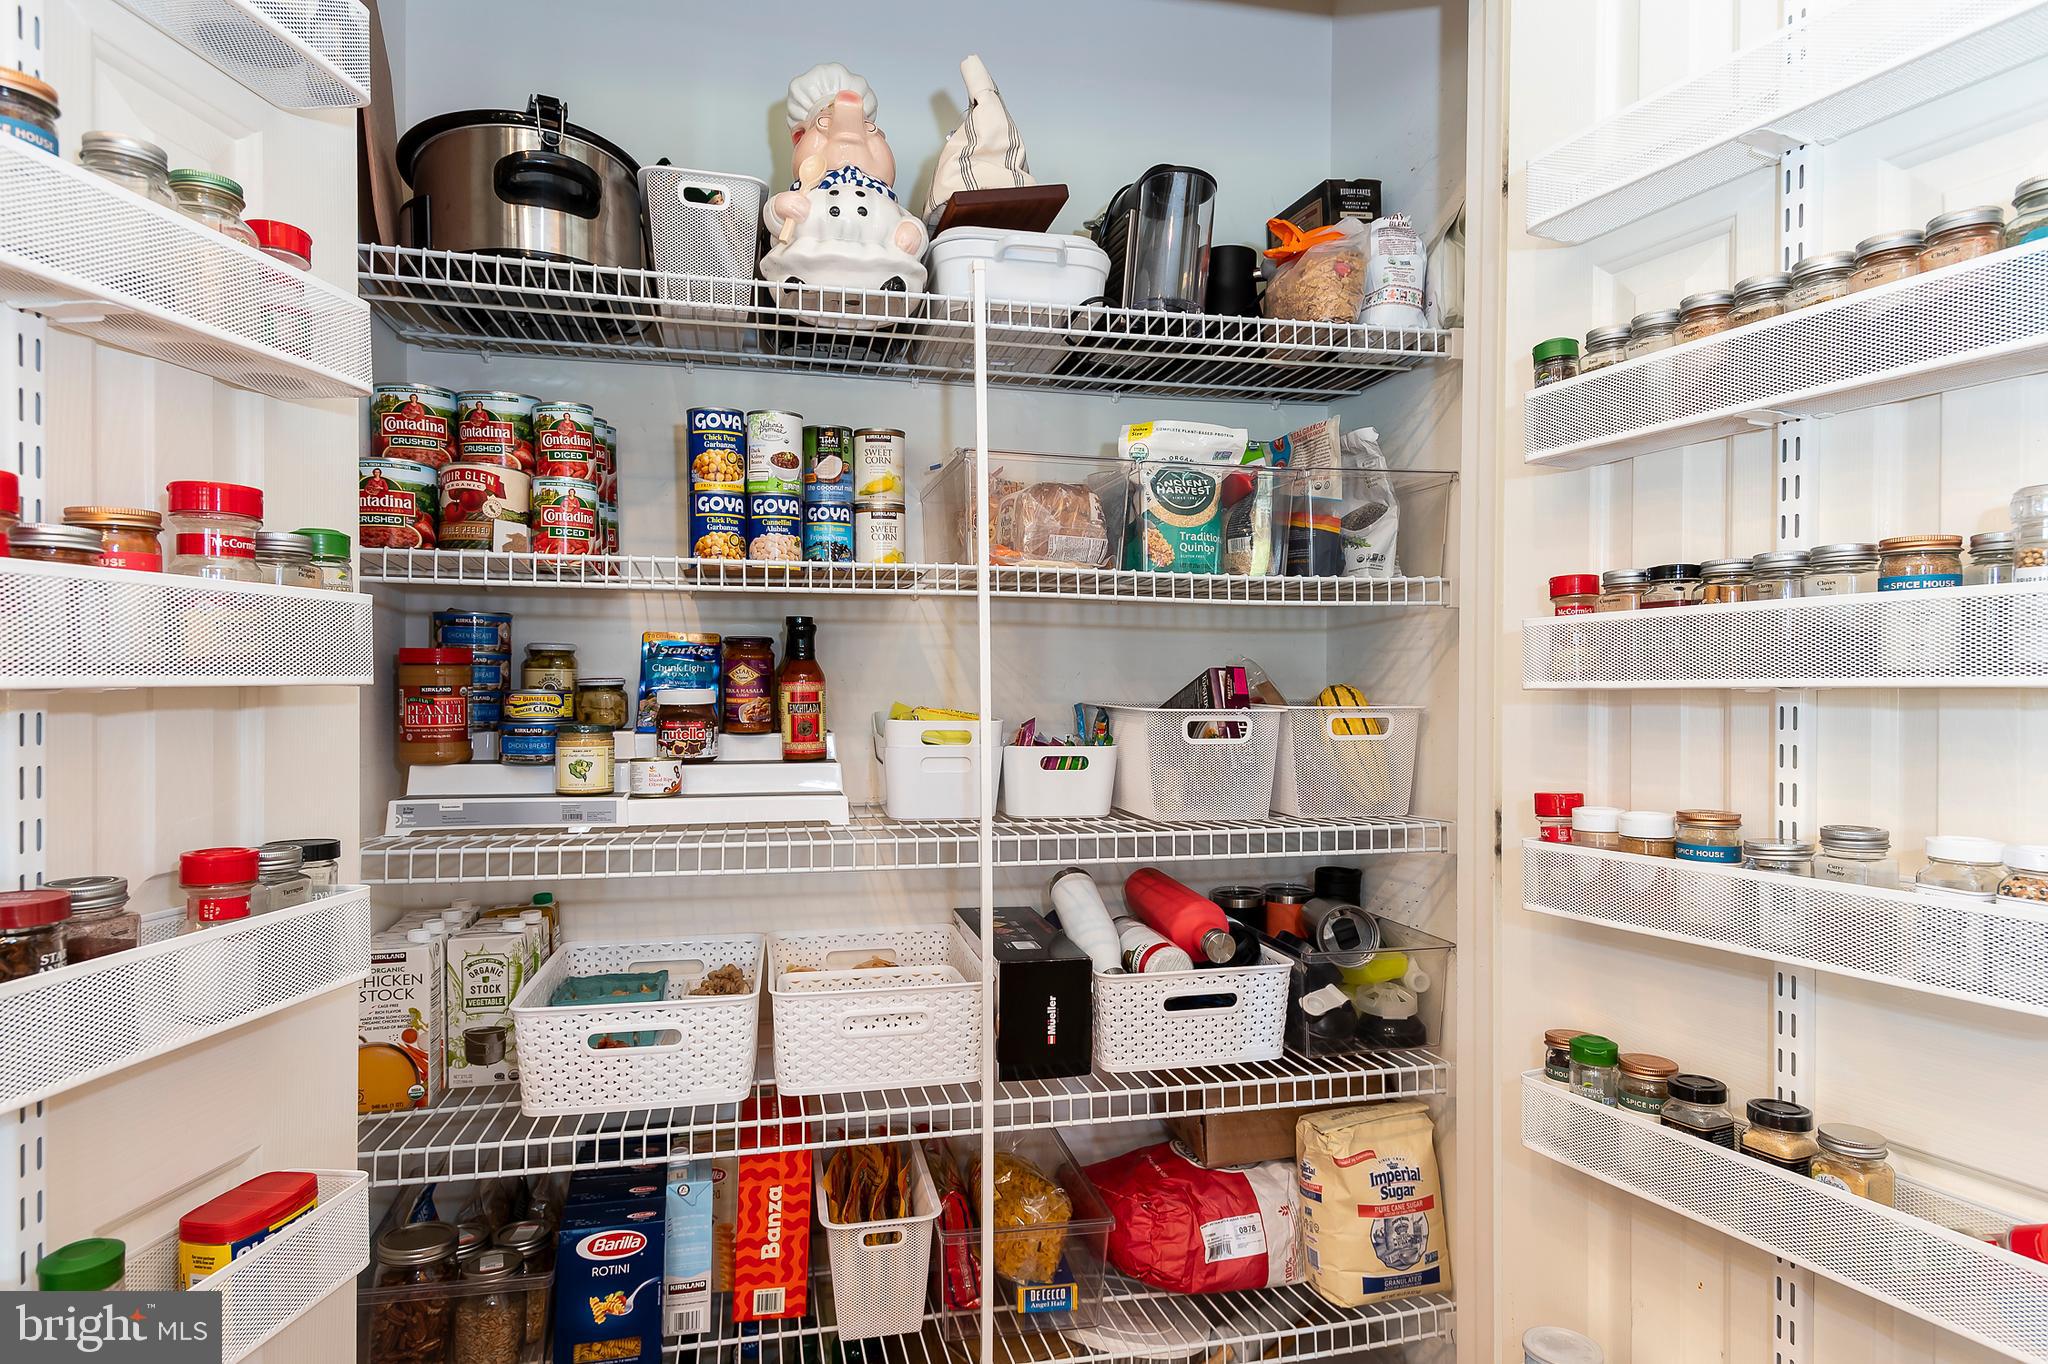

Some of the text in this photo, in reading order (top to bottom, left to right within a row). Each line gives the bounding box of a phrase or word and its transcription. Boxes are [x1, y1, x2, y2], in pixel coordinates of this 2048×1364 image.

[1931, 246, 1961, 259] Chipotle
[383, 416, 445, 434] Contadina
[695, 413, 742, 430] GOYA
[460, 424, 511, 439] Contadina
[392, 437, 437, 447] CRUSHED
[542, 433, 591, 447] Contadina
[704, 441, 736, 449] Garbanzos
[819, 436, 839, 444] THAI
[464, 444, 501, 453] CRUSHED
[864, 449, 892, 457] SWEET
[554, 451, 583, 459] DICED
[865, 456, 891, 464] CORN
[465, 470, 495, 486] GLEN
[1157, 479, 1208, 488] ANCIENT
[1156, 485, 1211, 496] HARVEST
[360, 495, 412, 509] ntadina
[698, 496, 744, 513] GOYA
[753, 499, 799, 514] GOYA
[544, 509, 593, 525] Contadina
[808, 507, 850, 521] GOYA
[556, 528, 585, 536] DICED
[707, 524, 739, 532] Garbanzos
[870, 526, 898, 534] SWEET
[871, 533, 897, 541] CORN
[1179, 542, 1215, 555] Quinoa
[1890, 579, 1956, 589] SPICE HOUSE
[660, 645, 715, 656] StarKist
[651, 664, 706, 674] Chunk Light
[408, 705, 462, 715] PEANUT
[533, 706, 560, 715] CLAMS
[789, 703, 820, 712] ENCHILADA
[408, 714, 462, 724] BUTTER
[662, 727, 706, 740] nutella
[1696, 850, 1724, 859] HOUSE
[1827, 863, 1844, 871] Curry
[1826, 869, 1845, 878] Powder
[283, 886, 303, 896] Tarragon
[469, 966, 504, 978] ORGANIC
[358, 973, 423, 988] HICKEN
[470, 984, 501, 994] STOCK
[360, 988, 415, 1003] STOCK
[469, 998, 504, 1006] VEGETABLE
[1626, 1097, 1647, 1108] SPICE
[1369, 1166, 1421, 1187] Imperial
[1380, 1185, 1416, 1200] Sugar
[1391, 1203, 1405, 1211] CANE
[1407, 1200, 1423, 1209] SUGAR
[761, 1185, 782, 1260] Banza
[1239, 1225, 1257, 1234] 0876
[593, 1236, 641, 1253] Barilla
[591, 1264, 630, 1277] ROTINI
[670, 1281, 706, 1291] KIRKLAND
[1384, 1276, 1422, 1287] GRANULATED
